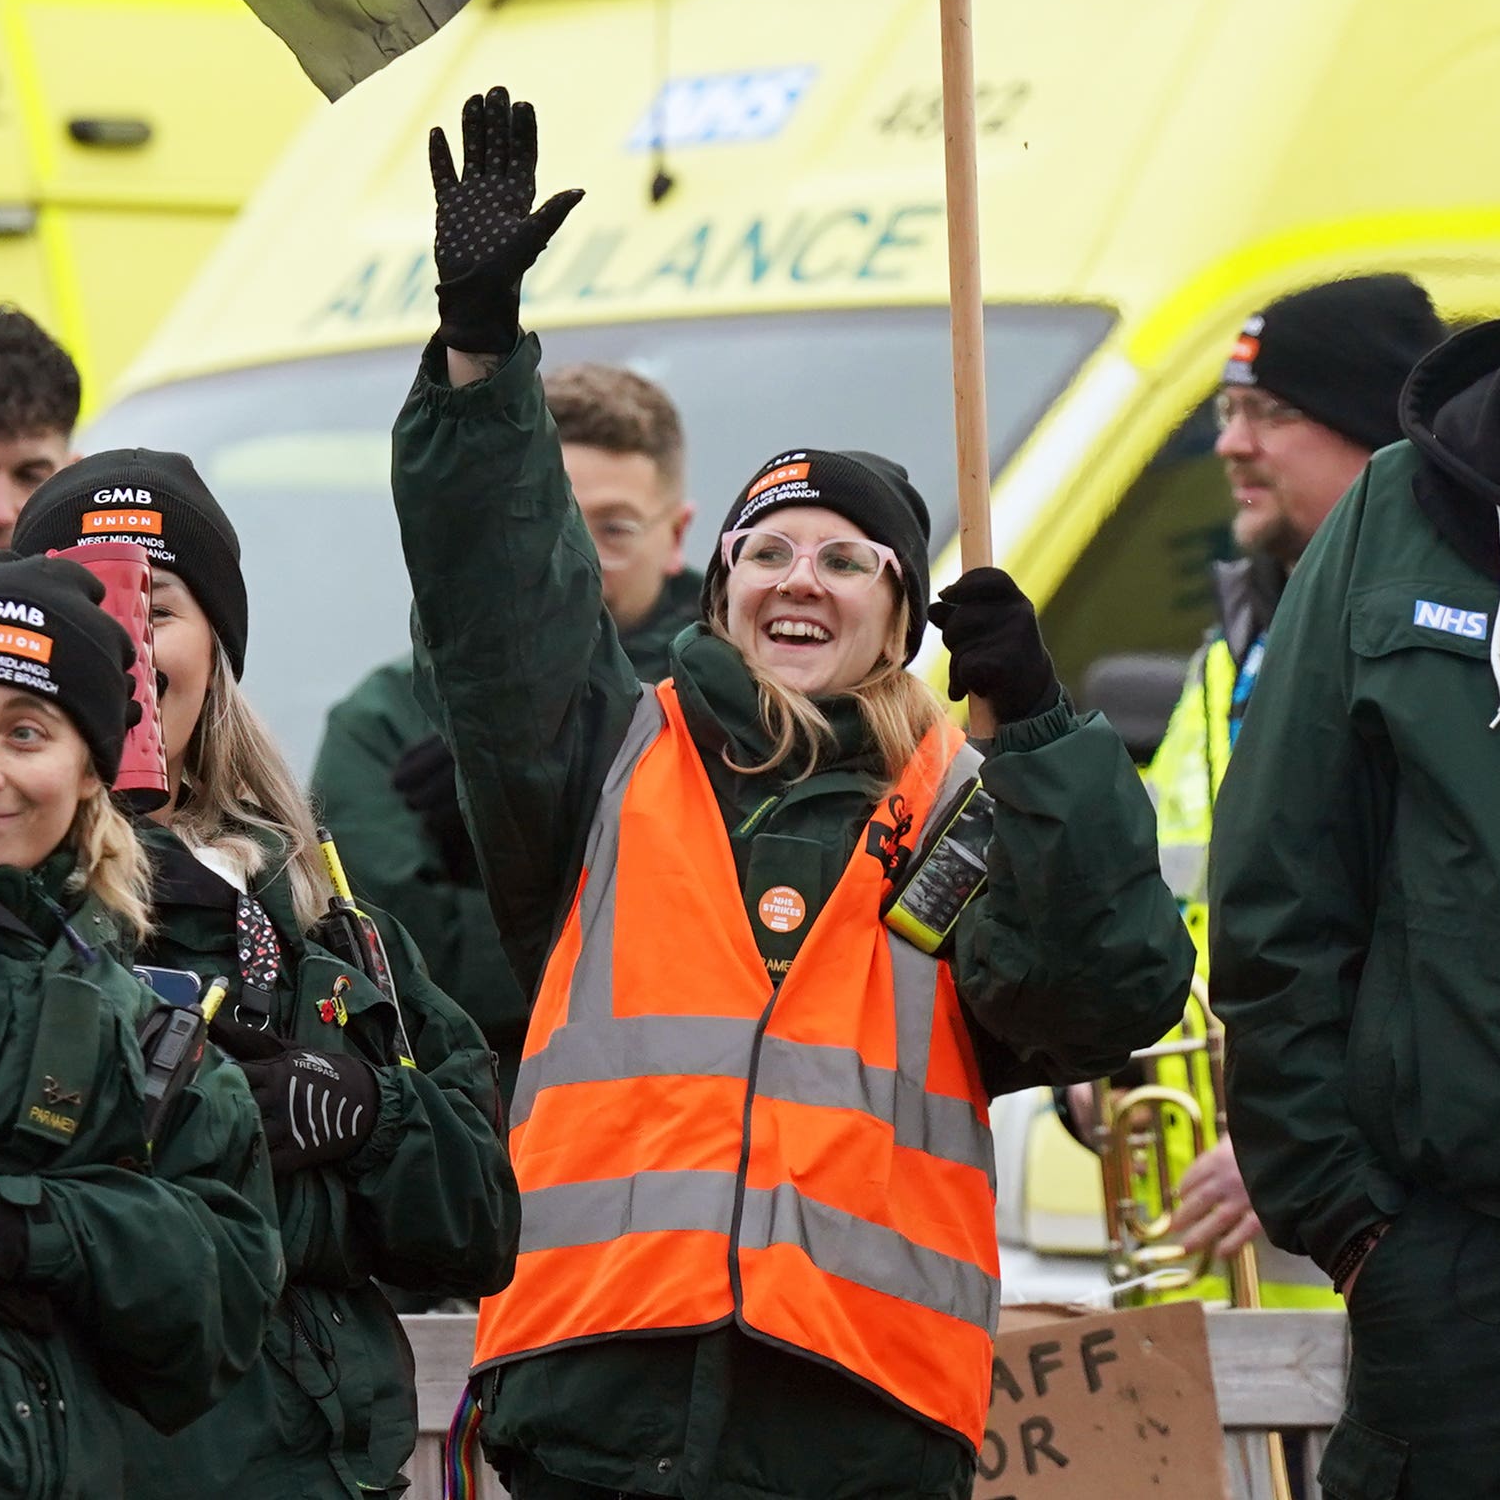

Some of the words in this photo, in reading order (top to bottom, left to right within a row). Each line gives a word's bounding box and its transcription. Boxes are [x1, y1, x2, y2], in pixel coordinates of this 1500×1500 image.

[306, 202, 947, 327] AMULANCE
[93, 487, 153, 505] GMB
[759, 481, 809, 501] MIDLANDS
[775, 489, 820, 501] BRANCH
[93, 516, 152, 527] UNION
[77, 536, 110, 547] WEST
[109, 535, 166, 550] MIDLANDS
[1416, 600, 1485, 638] NHS
[13, 671, 60, 695] BRANCH
[763, 903, 802, 918] STRIKES
[773, 896, 794, 907] NHS
[292, 1059, 340, 1081] TRESPASS
